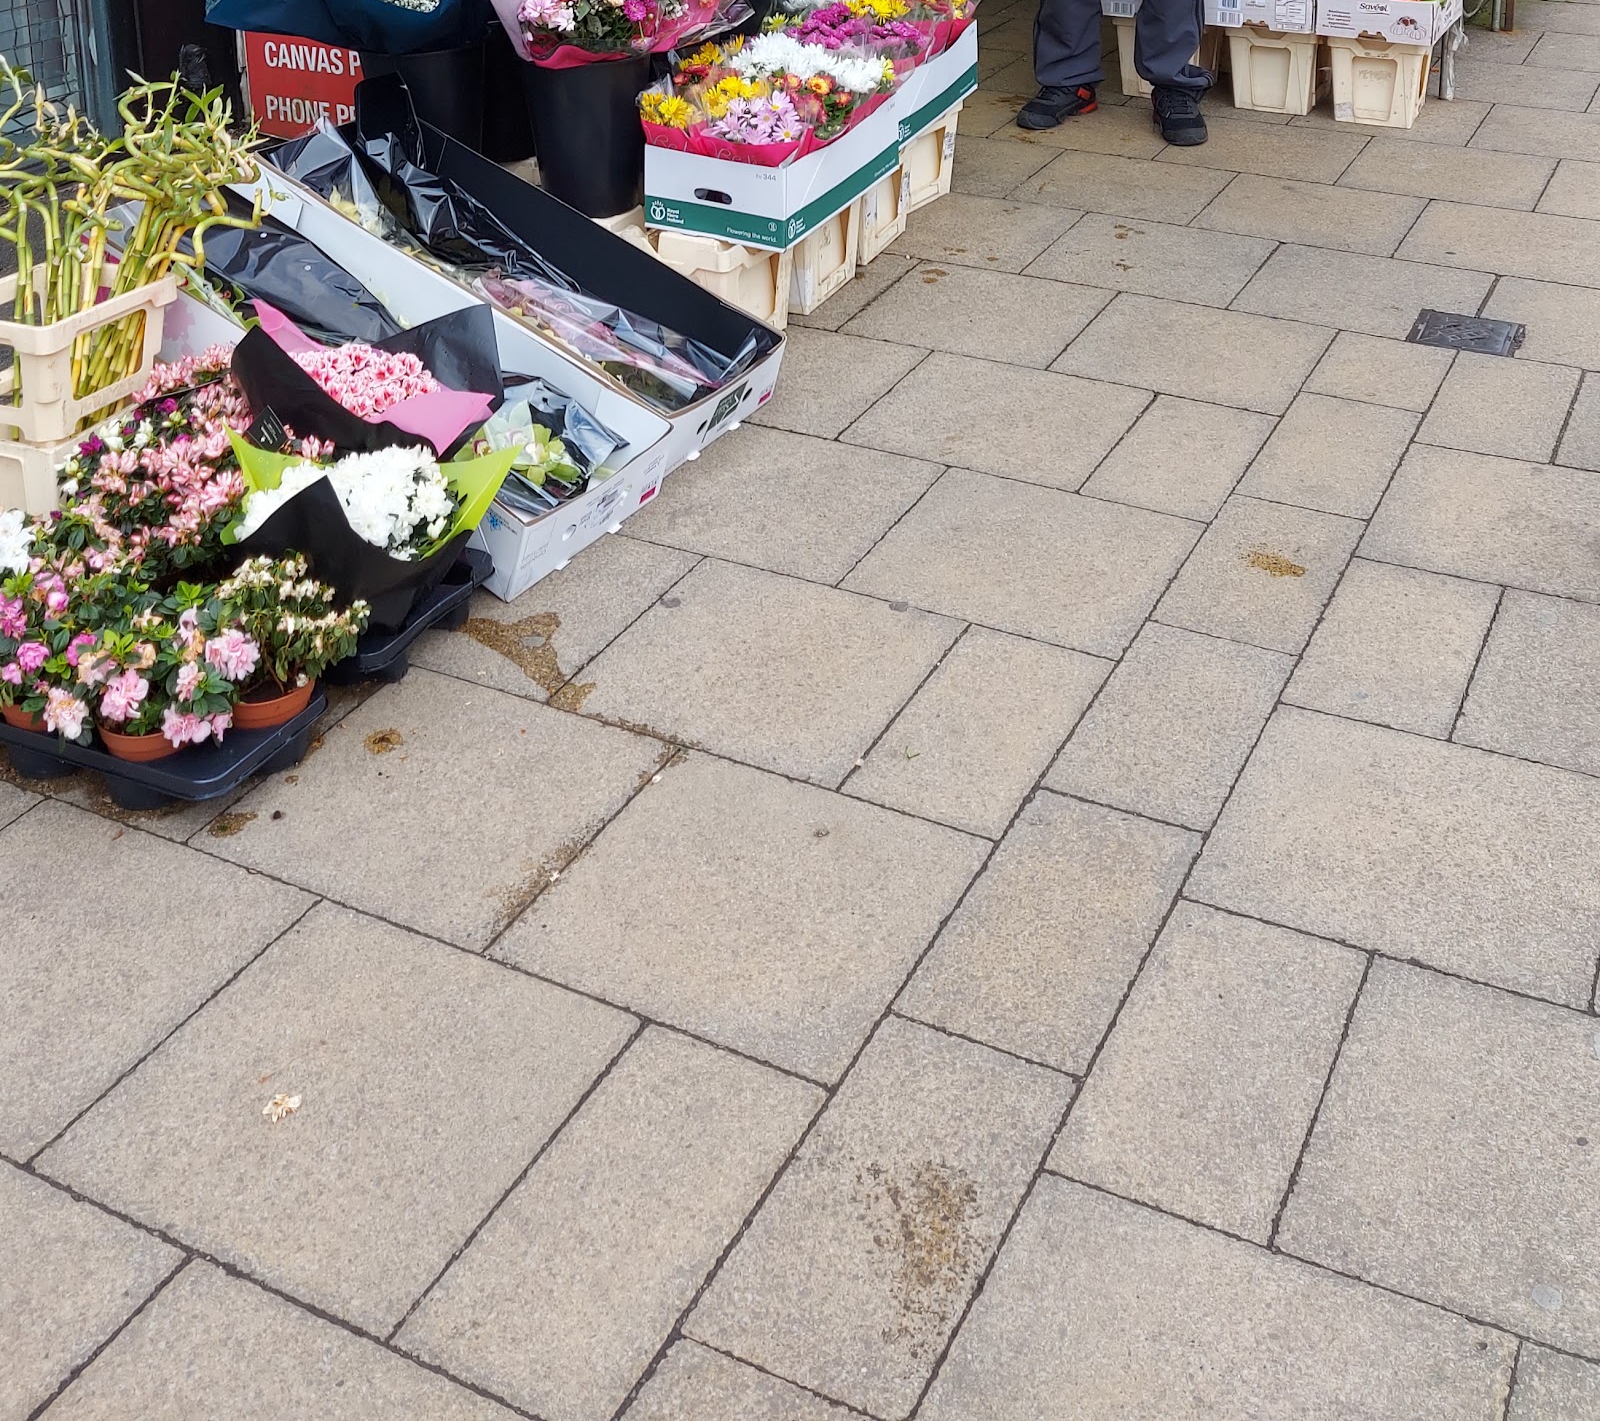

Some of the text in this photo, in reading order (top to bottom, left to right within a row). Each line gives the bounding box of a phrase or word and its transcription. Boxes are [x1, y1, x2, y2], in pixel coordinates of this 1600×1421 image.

[264, 41, 344, 75] CANVAS
[265, 94, 330, 126] PHONE
[763, 173, 777, 182] 344
